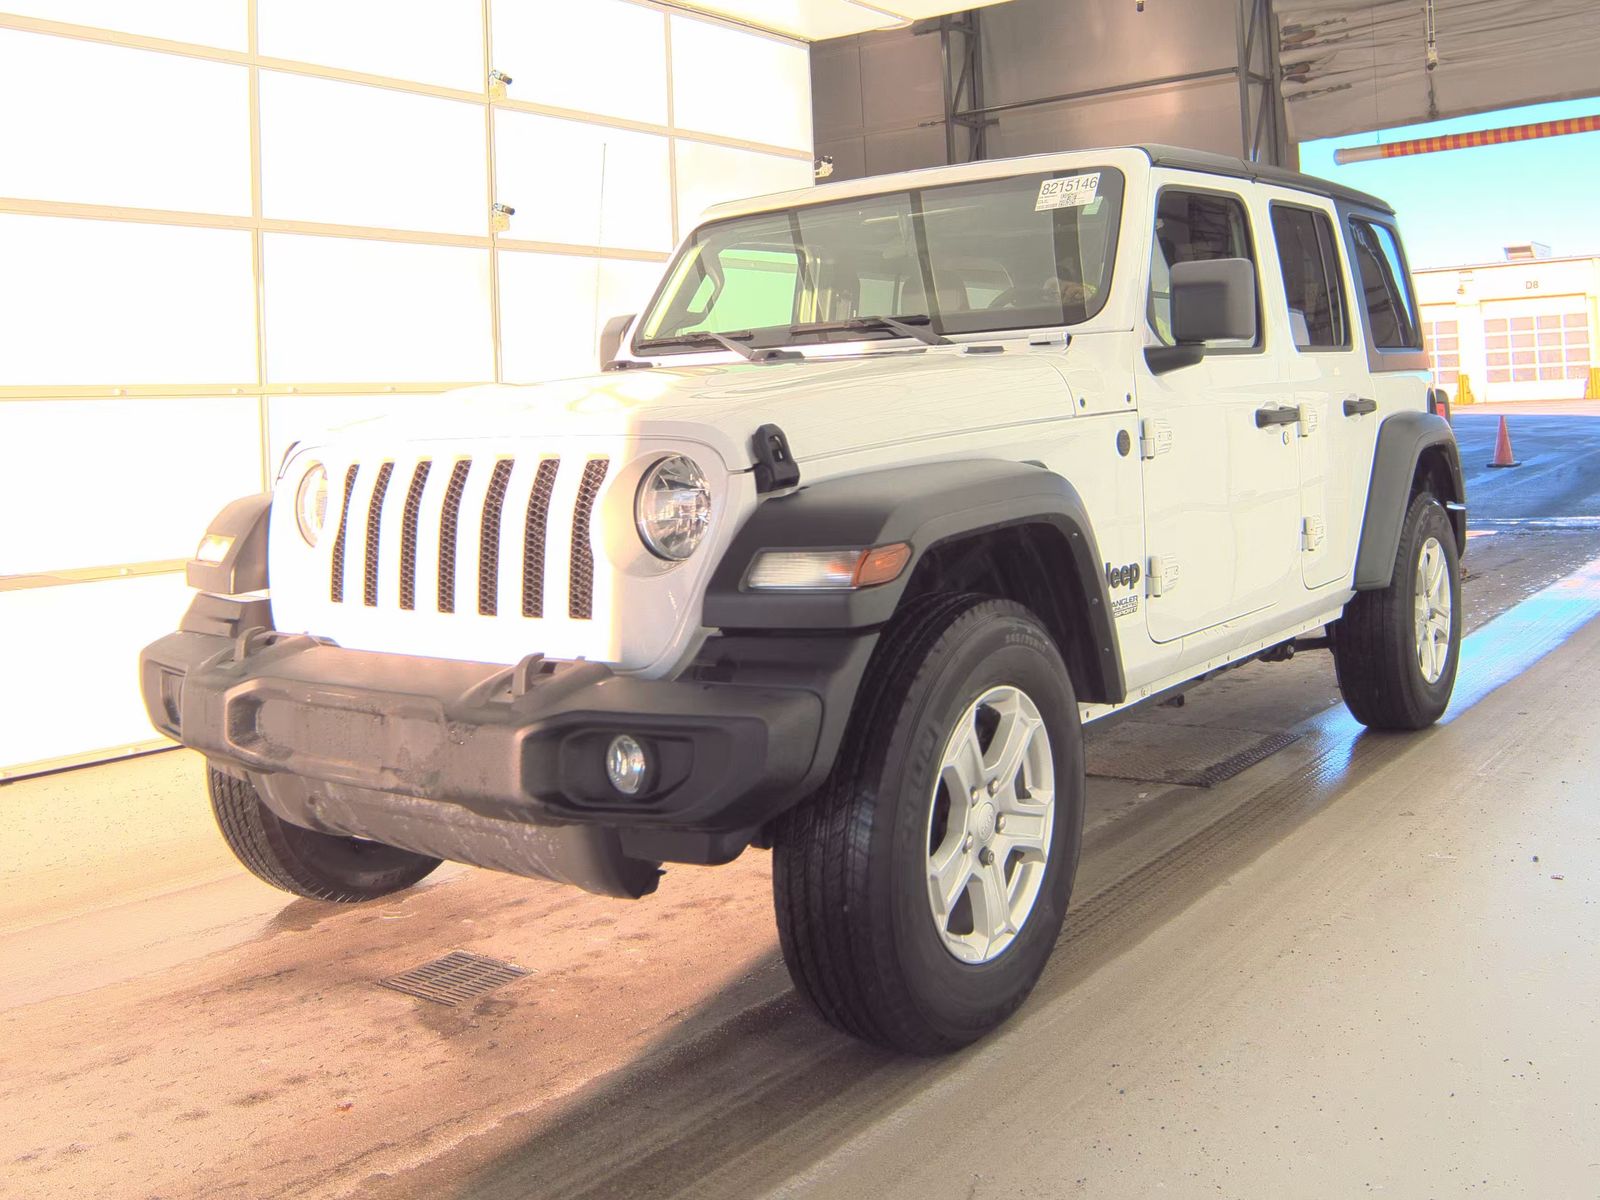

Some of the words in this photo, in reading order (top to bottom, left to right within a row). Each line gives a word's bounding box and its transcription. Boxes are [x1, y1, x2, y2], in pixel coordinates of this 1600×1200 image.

[1041, 177, 1098, 195] 8215146
[1525, 280, 1539, 290] D8
[1112, 595, 1138, 607] ANGLER
